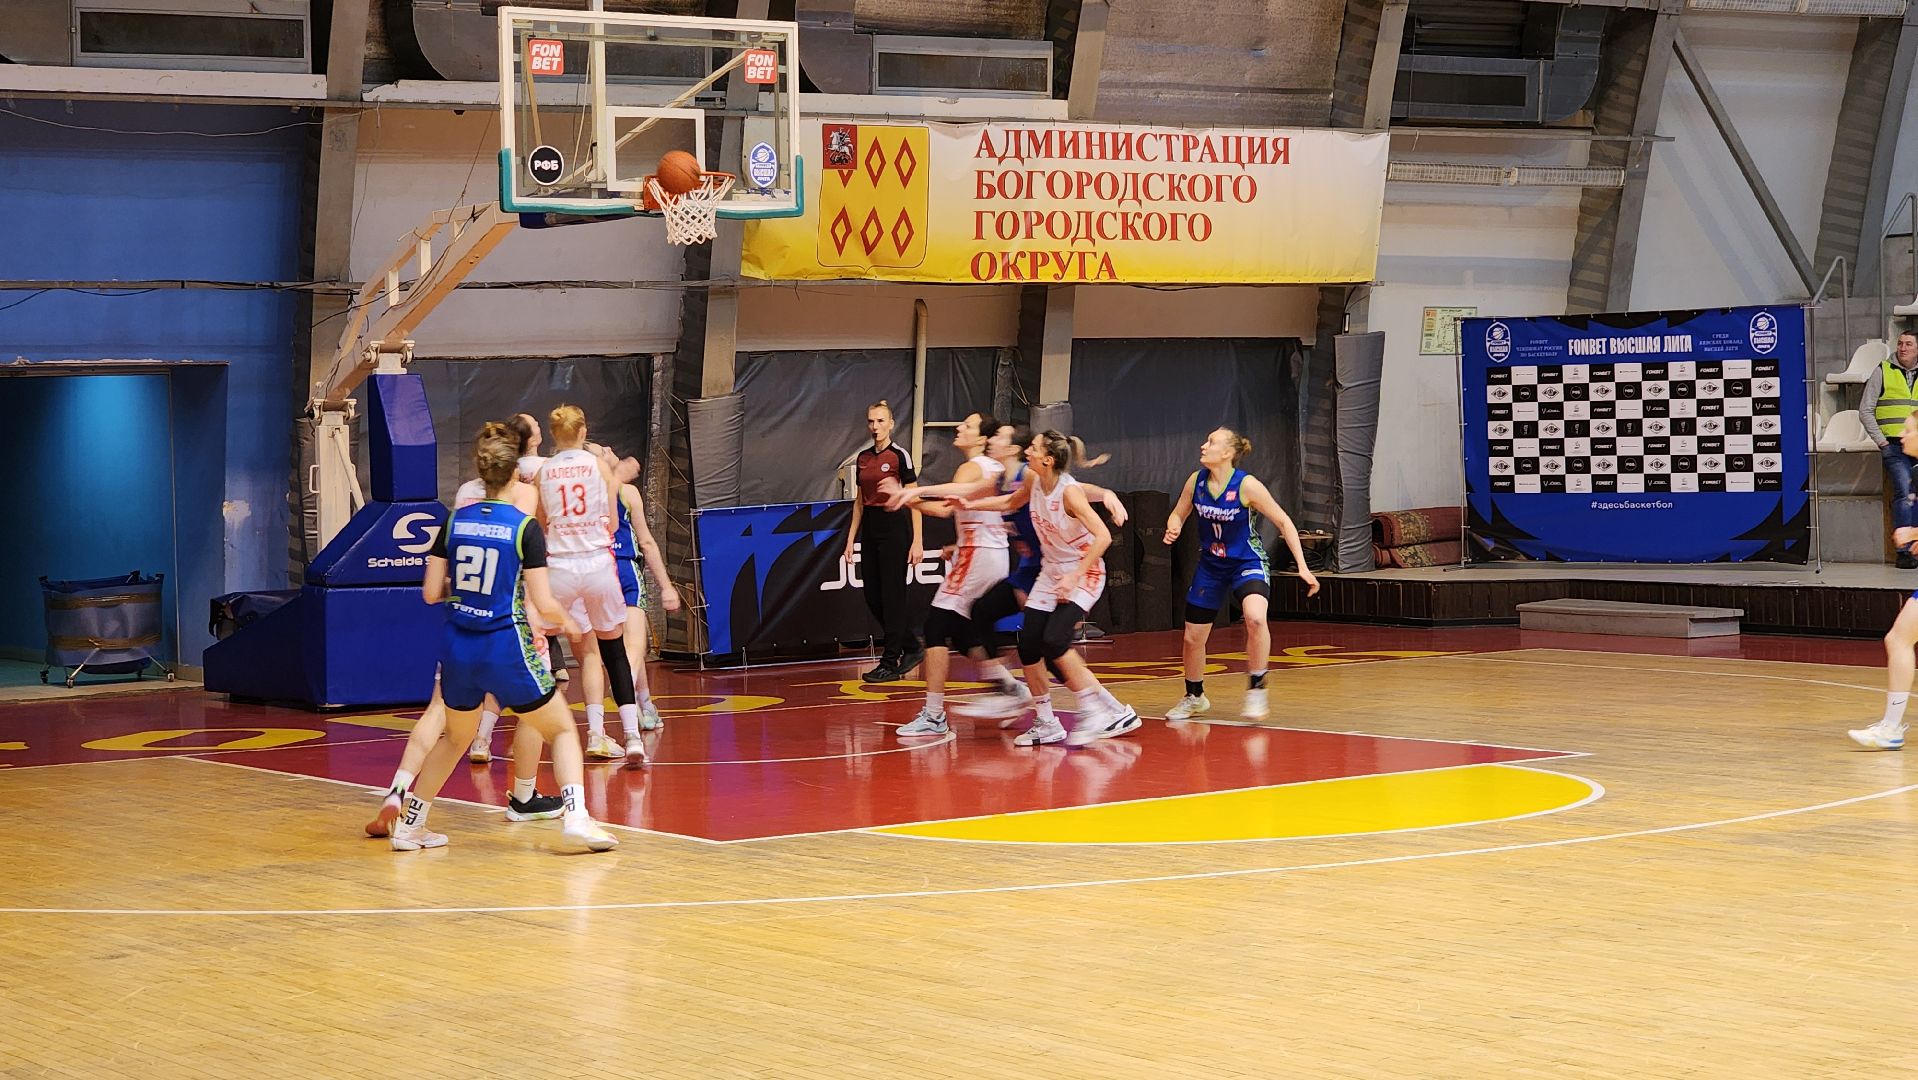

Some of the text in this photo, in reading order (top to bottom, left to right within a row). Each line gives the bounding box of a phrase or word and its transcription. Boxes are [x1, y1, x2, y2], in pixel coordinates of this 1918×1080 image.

[532, 44, 561, 57] FON
[532, 57, 561, 70] BET
[747, 54, 773, 66] FON
[747, 67, 774, 79] BET
[974, 129, 1291, 167] АДМИНИСТРАЦИЯ
[534, 160, 558, 170] РФБ
[973, 170, 1257, 208] БОГОРОДСКОГО
[973, 210, 1213, 246] ГОРОДСКОГО
[971, 251, 1117, 281] ОКРУГА
[1569, 335, 1692, 356] FONBET ВЫСШАЯ ЛИГА
[557, 484, 587, 516] 13
[1592, 500, 1673, 510] #здесьбаскетбол
[368, 556, 423, 568] Schelde
[455, 545, 499, 595] 21
